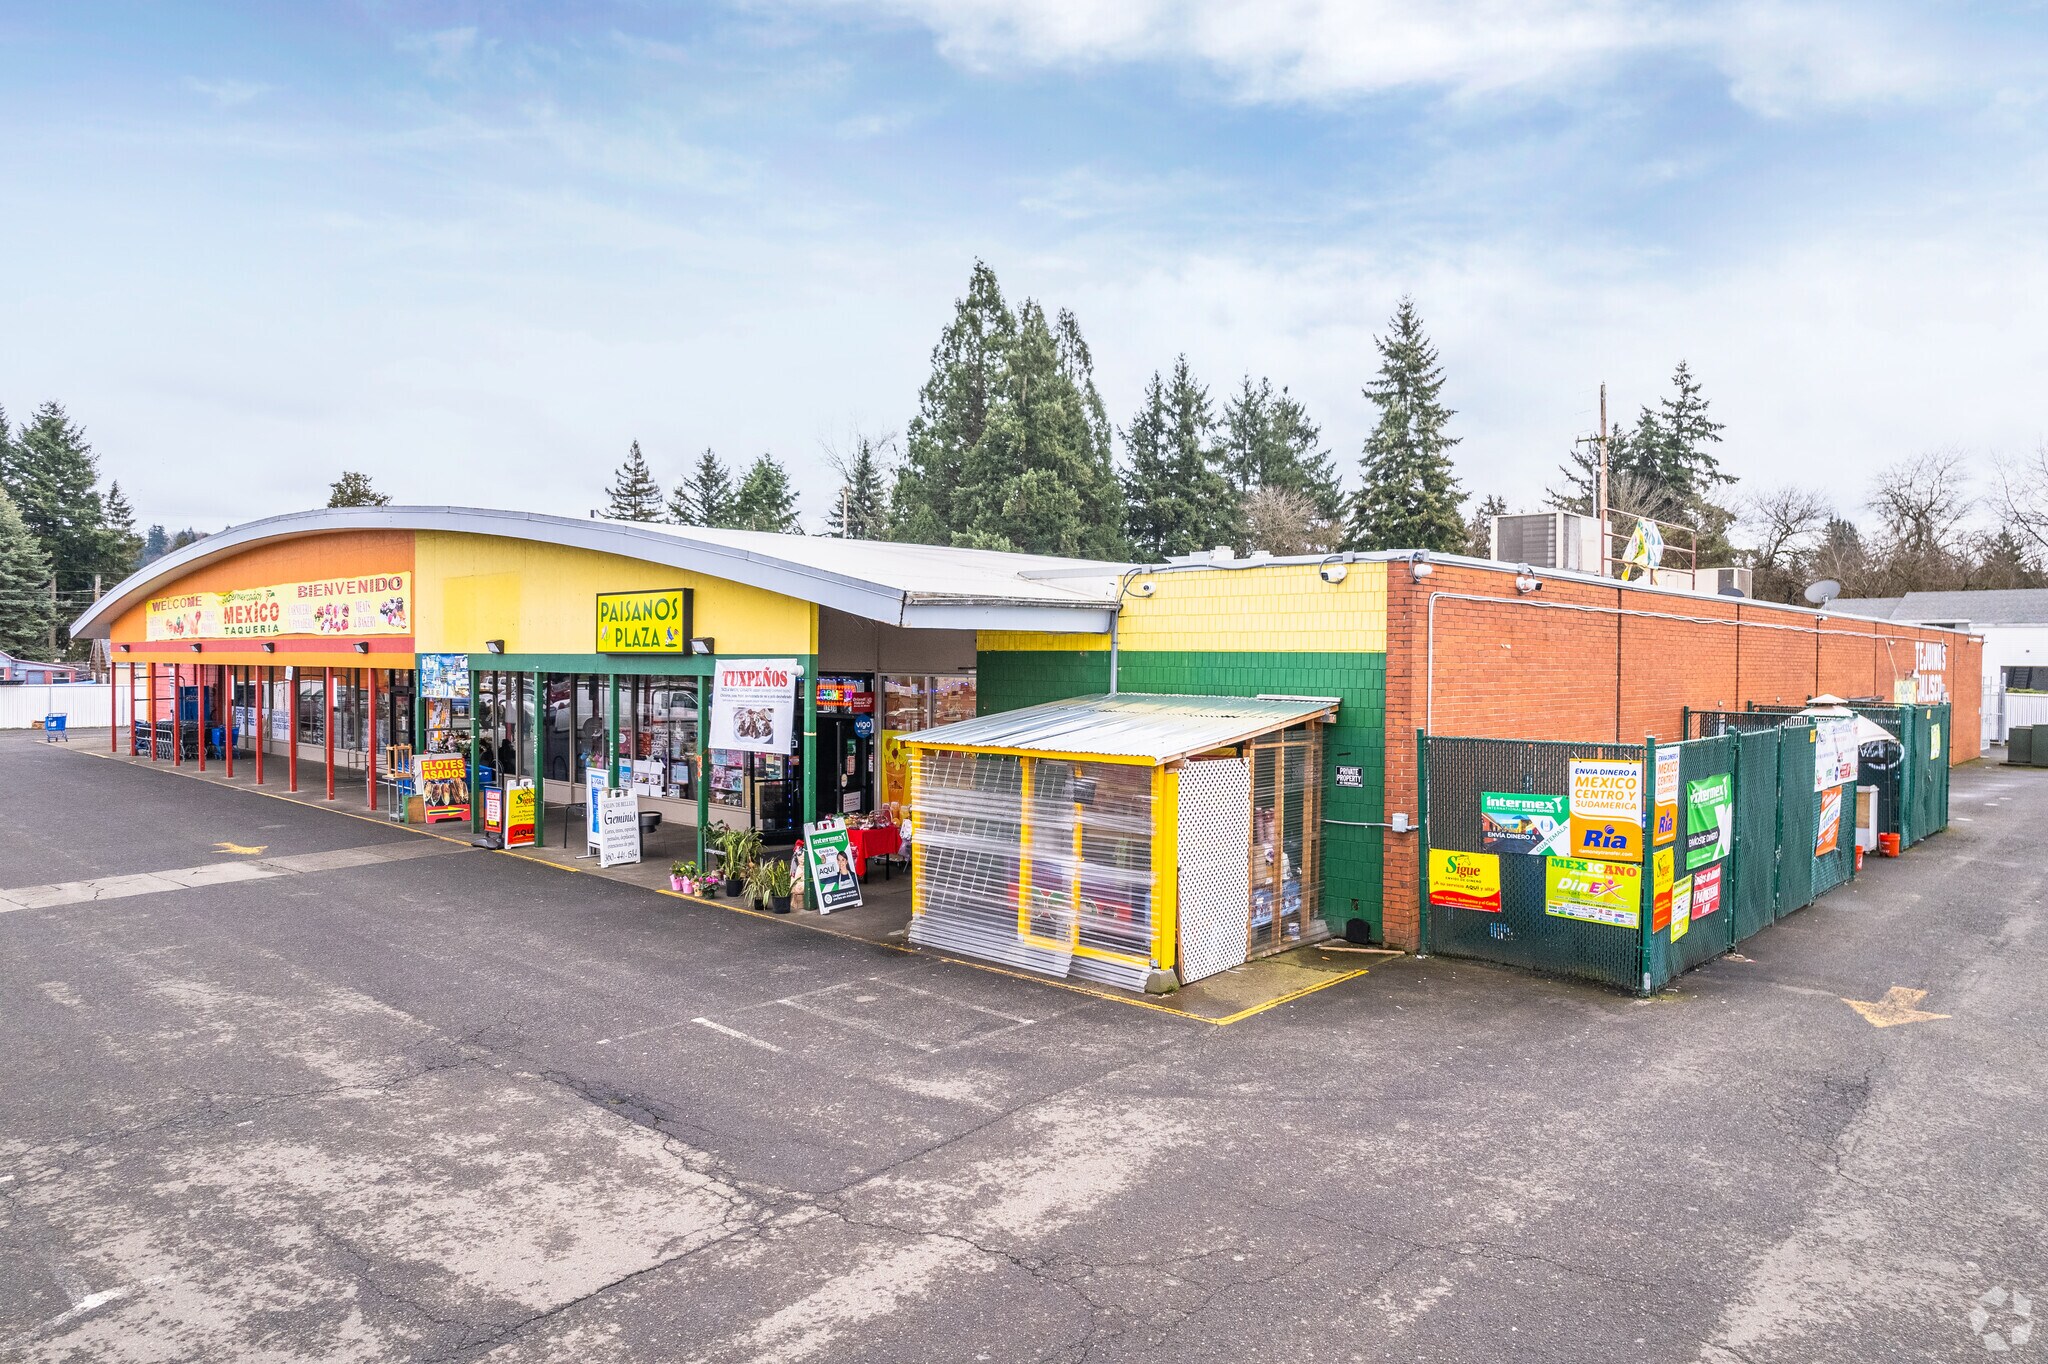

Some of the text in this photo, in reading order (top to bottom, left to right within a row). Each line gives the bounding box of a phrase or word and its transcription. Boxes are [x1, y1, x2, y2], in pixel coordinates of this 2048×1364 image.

[298, 576, 403, 598] BIENVENIDO
[152, 596, 202, 612] WELCOME
[601, 598, 678, 622] PAISANOS
[225, 624, 279, 635] TAQUERIA
[616, 627, 660, 647] PLAZA
[722, 666, 788, 687] TUXPEÑOS
[856, 720, 871, 729] vigo
[422, 760, 464, 770] ELOTES
[1340, 767, 1358, 775] PRIVATE
[1658, 761, 1678, 774] MEXICO
[424, 769, 466, 779] ASADOS
[1657, 775, 1674, 786] CENTRO
[1575, 776, 1637, 790] MEXICO
[1575, 789, 1636, 800] CENTRO Y
[1486, 796, 1555, 810] intermex
[1575, 800, 1637, 810] SUDAMERICA
[1658, 809, 1673, 834] Ria
[1536, 825, 1568, 853] GUATEMALA
[1583, 824, 1627, 849] Ria
[1446, 856, 1480, 878] Sigue
[1551, 858, 1637, 877] MEXICANO
